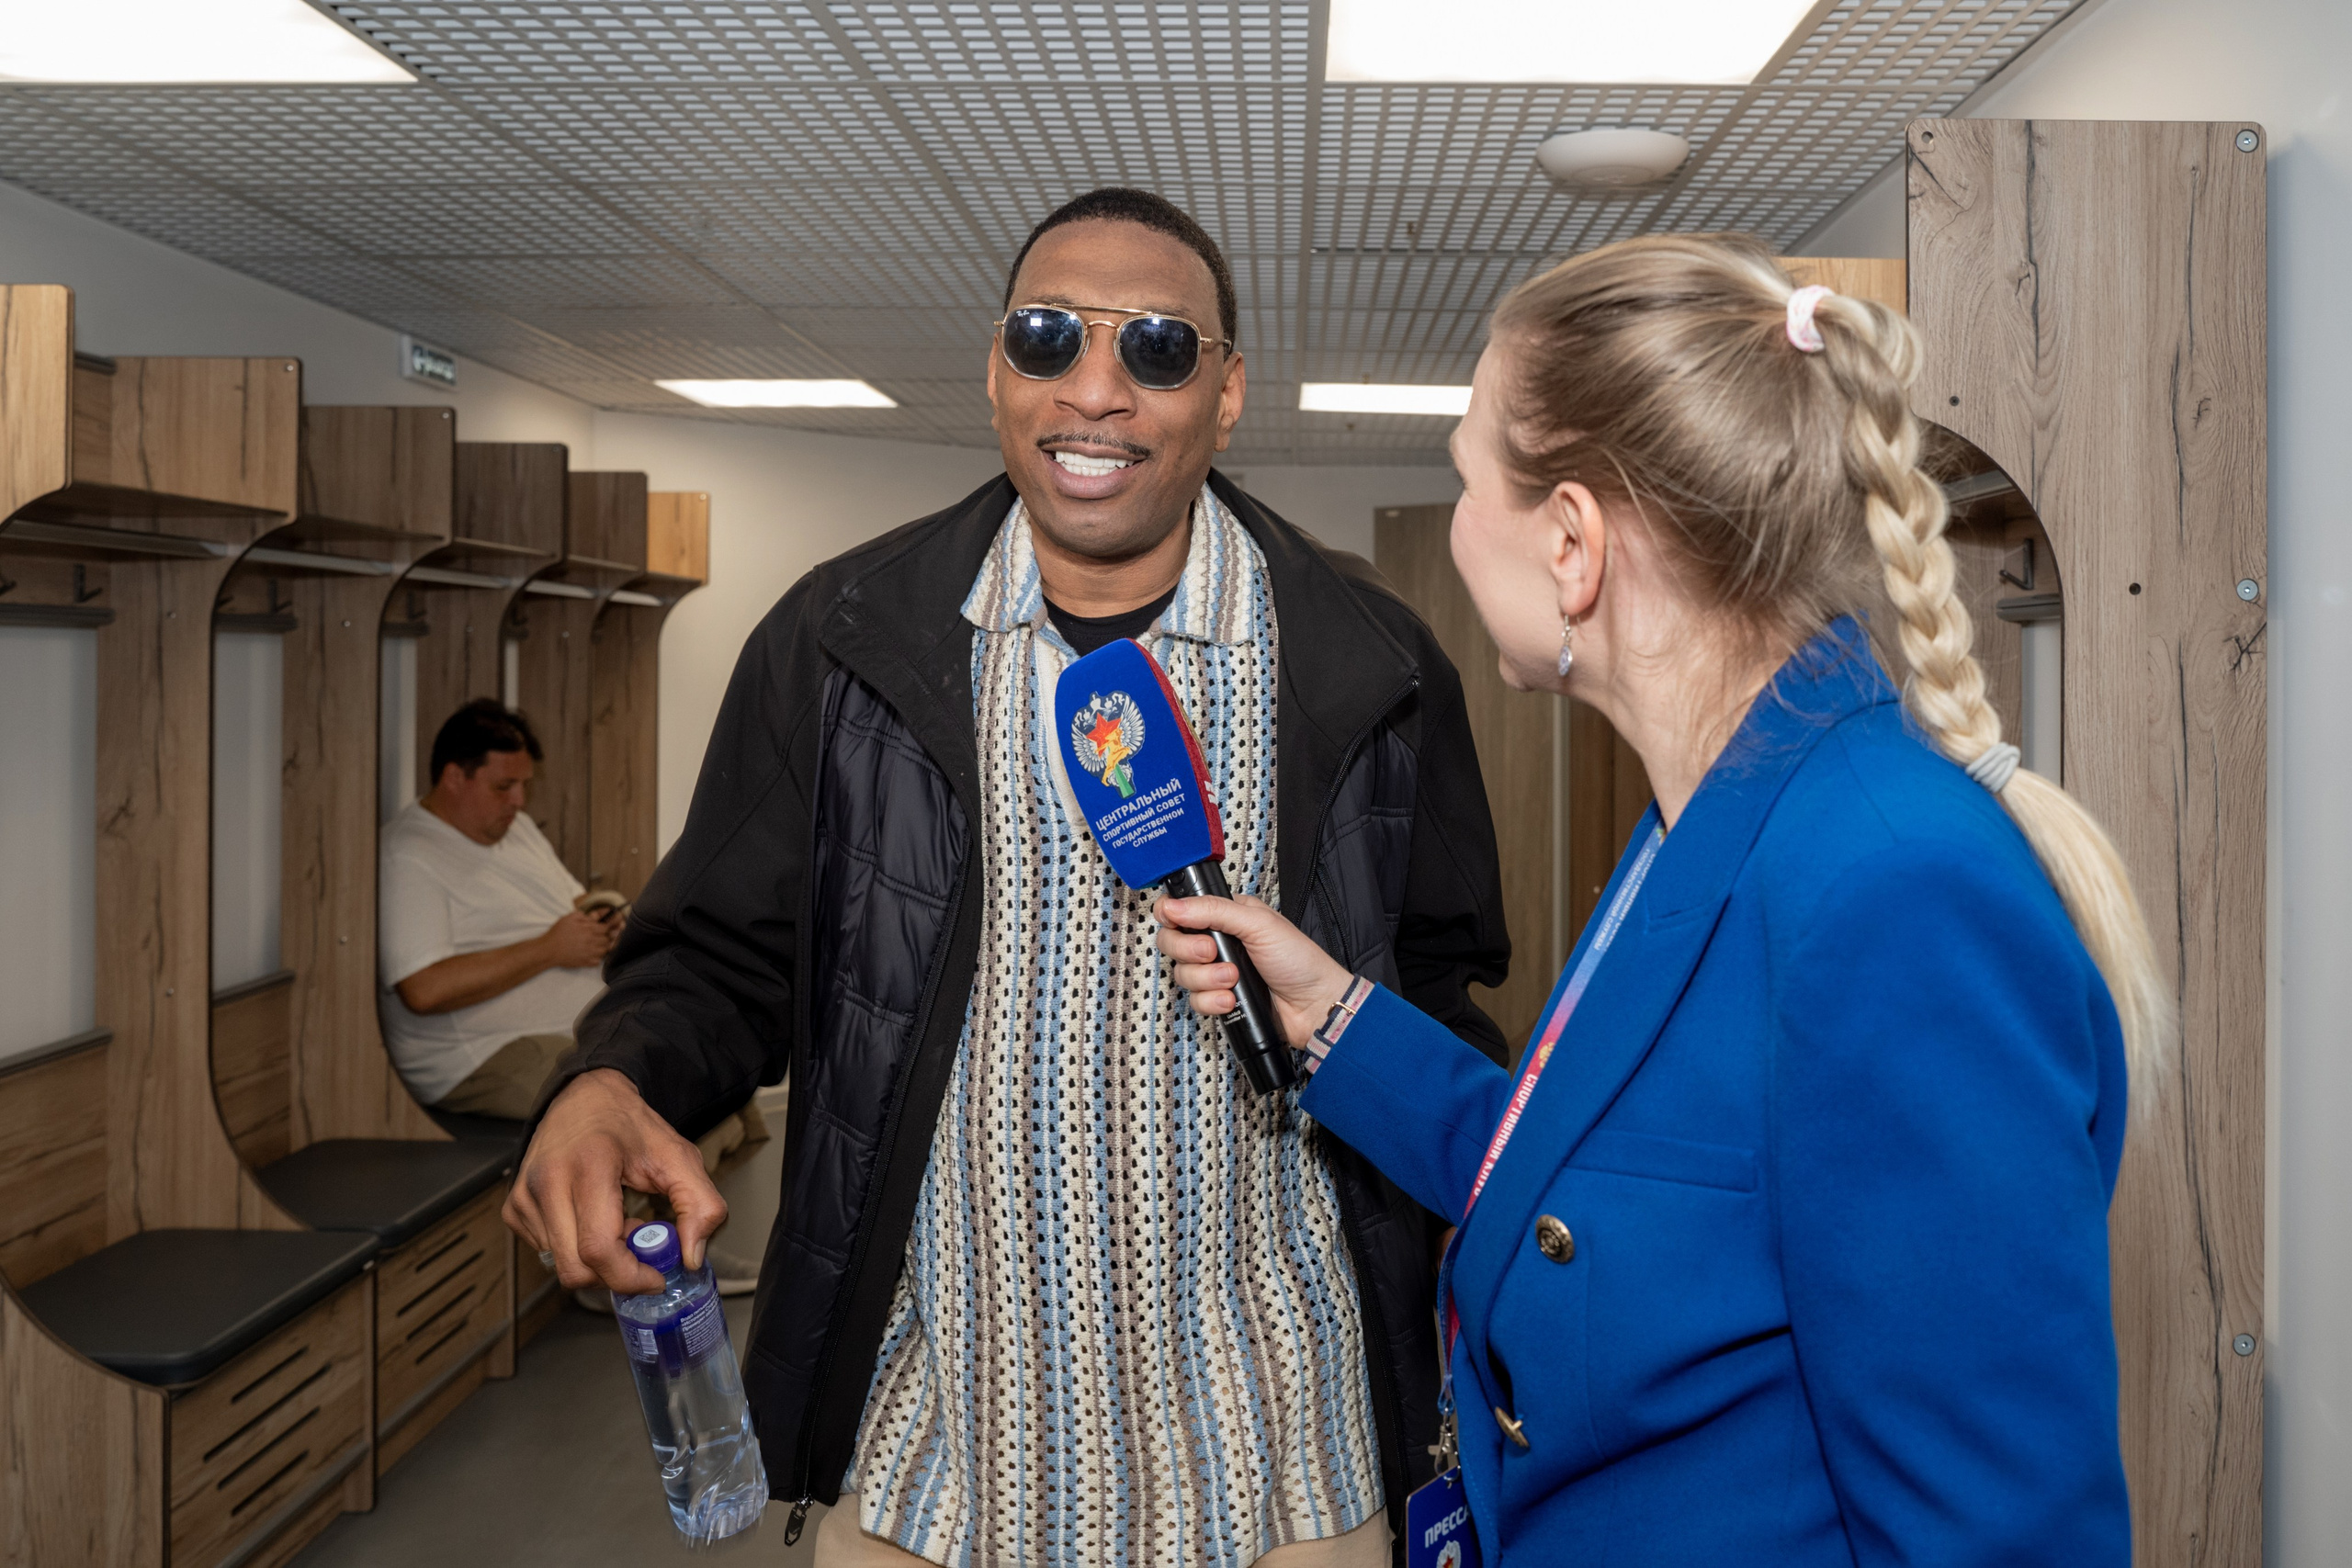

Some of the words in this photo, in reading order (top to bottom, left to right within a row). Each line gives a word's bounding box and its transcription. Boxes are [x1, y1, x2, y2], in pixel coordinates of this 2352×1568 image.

[1095, 778, 1182, 831] ЦЕНТРАЛЬНЫЙ
[1102, 807, 1155, 841] СПОРТИВНЫЙ
[1156, 794, 1185, 813] СОВЕТ
[1133, 827, 1168, 847] СЛУЖБЫ
